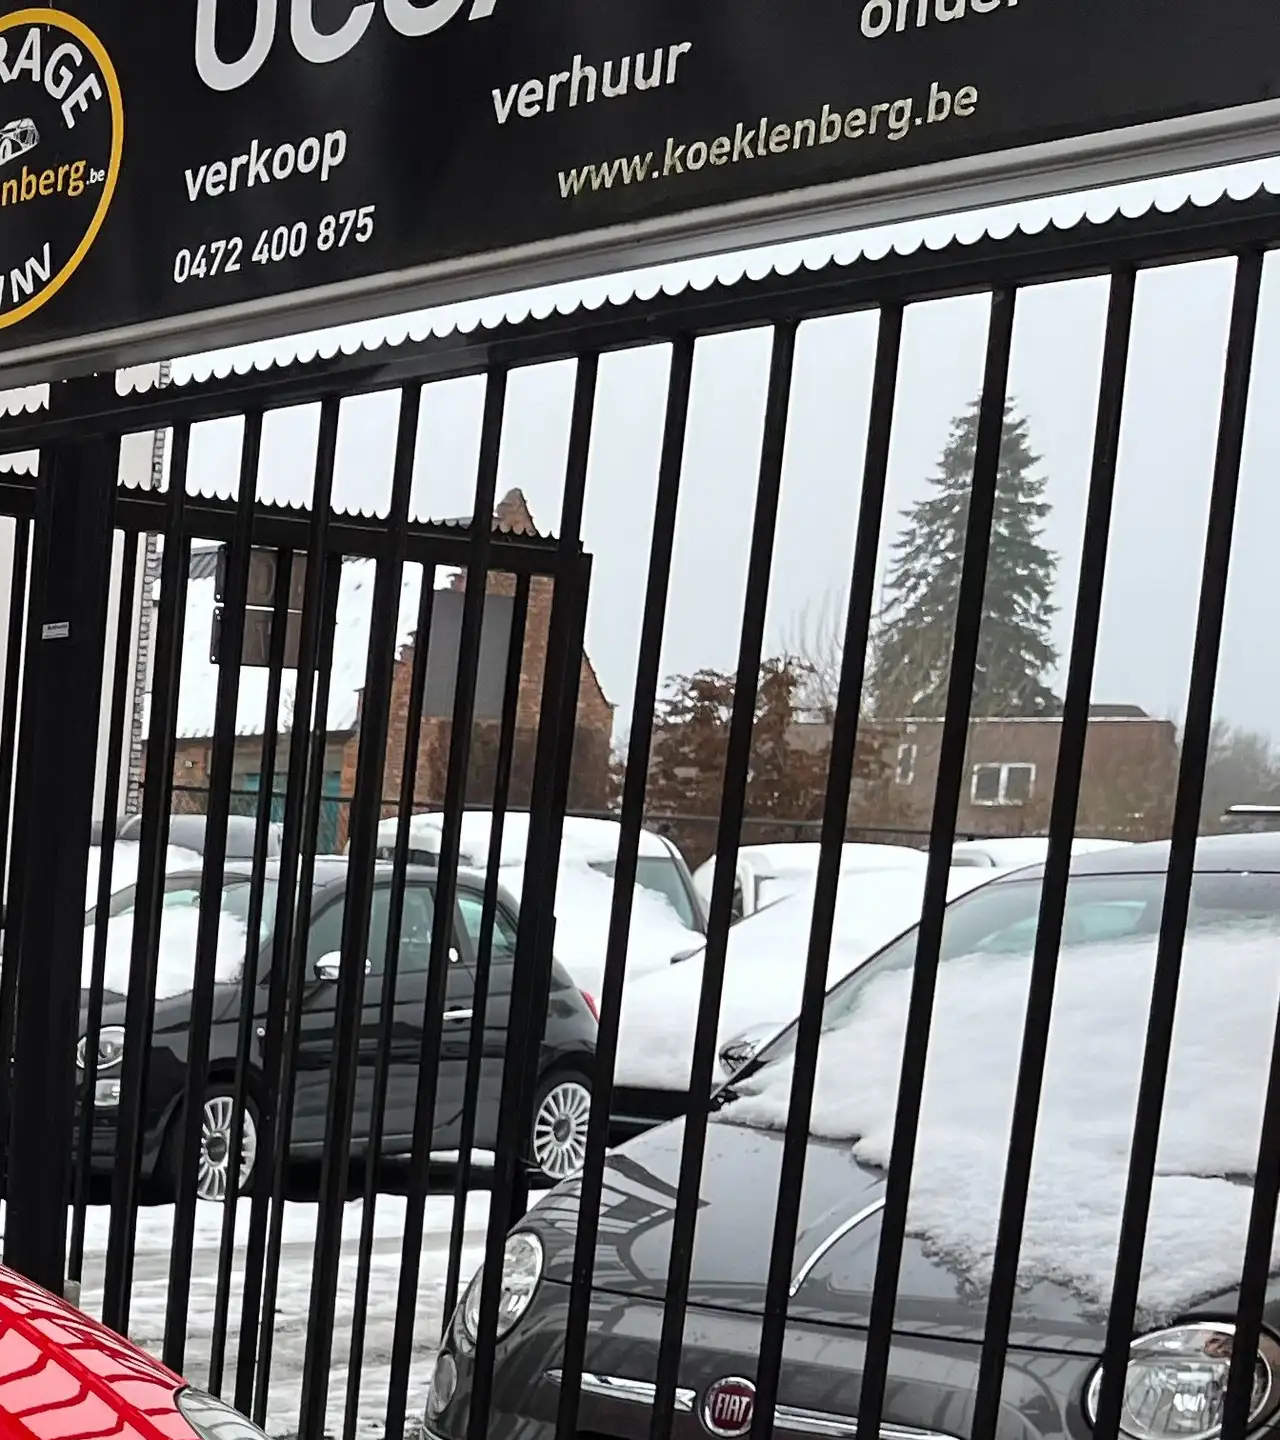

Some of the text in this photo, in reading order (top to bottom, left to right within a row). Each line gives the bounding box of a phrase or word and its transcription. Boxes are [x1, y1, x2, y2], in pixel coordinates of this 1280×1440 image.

[491, 41, 692, 125] verhuur
[184, 129, 347, 202] verkoop
[556, 81, 979, 199] www.koeklenberg.be
[12, 242, 51, 303] NV
[173, 205, 376, 284] 0472 400 875
[714, 1392, 751, 1422] FIAT
